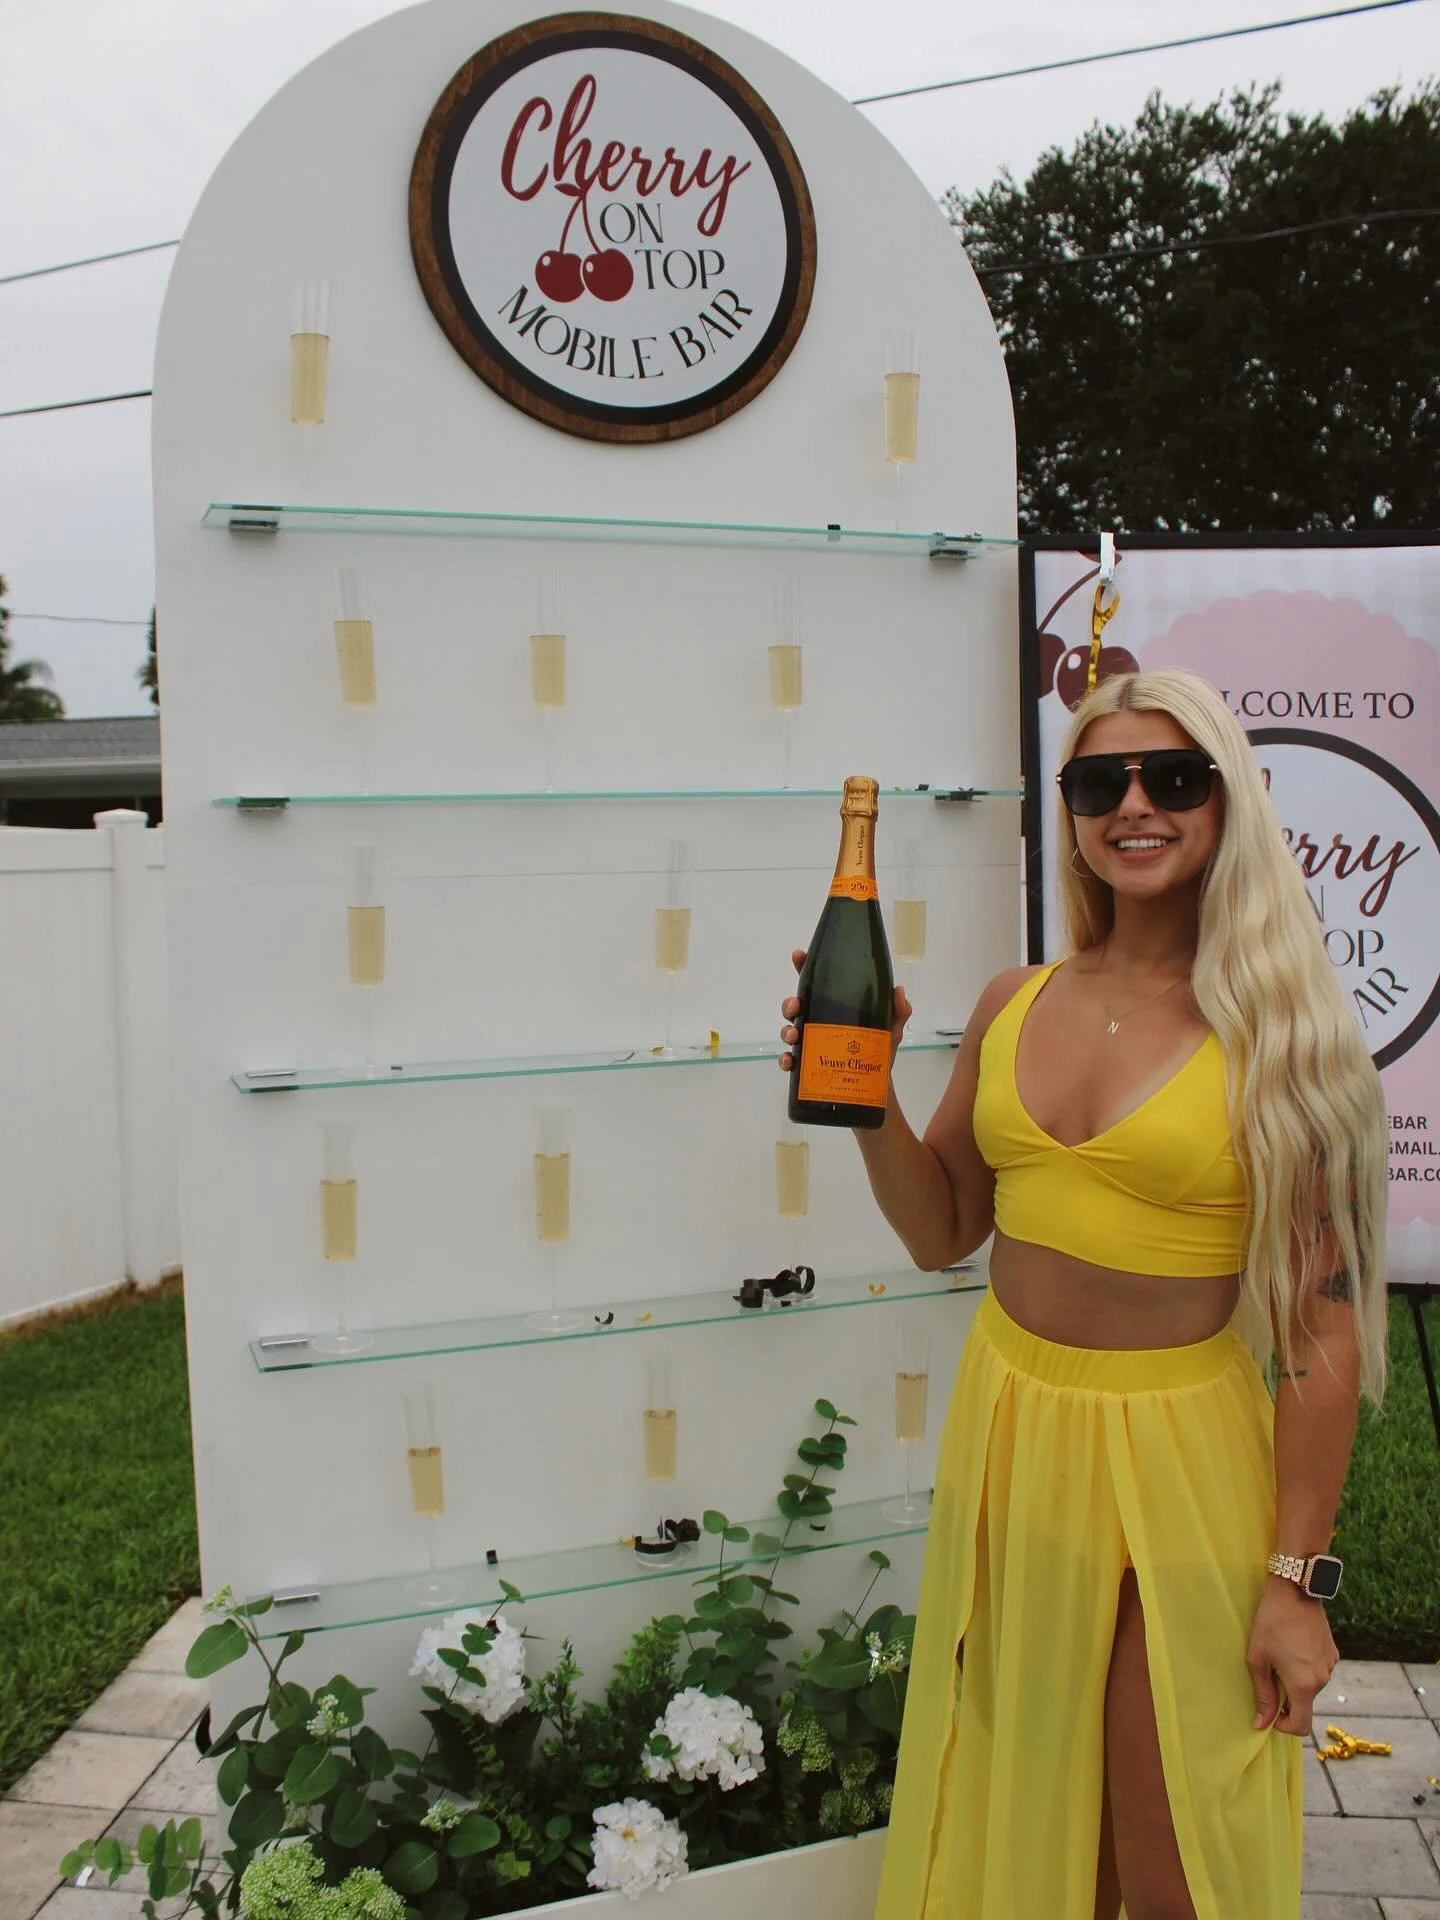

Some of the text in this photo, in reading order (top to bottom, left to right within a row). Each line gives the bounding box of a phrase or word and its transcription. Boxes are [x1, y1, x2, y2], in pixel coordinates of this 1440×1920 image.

[501, 74, 751, 237] Cherry
[600, 202, 664, 244] ON
[634, 249, 726, 290] TOP
[498, 285, 753, 379] MOBILE BAR
[1364, 692, 1415, 719] TO
[1281, 826, 1420, 917] rry
[1323, 929, 1384, 967] OP
[1353, 967, 1409, 1029] AR
[819, 1056, 846, 1067] Veuve
[847, 1059, 882, 1073] Clicquot
[1388, 1115, 1427, 1130] BAR
